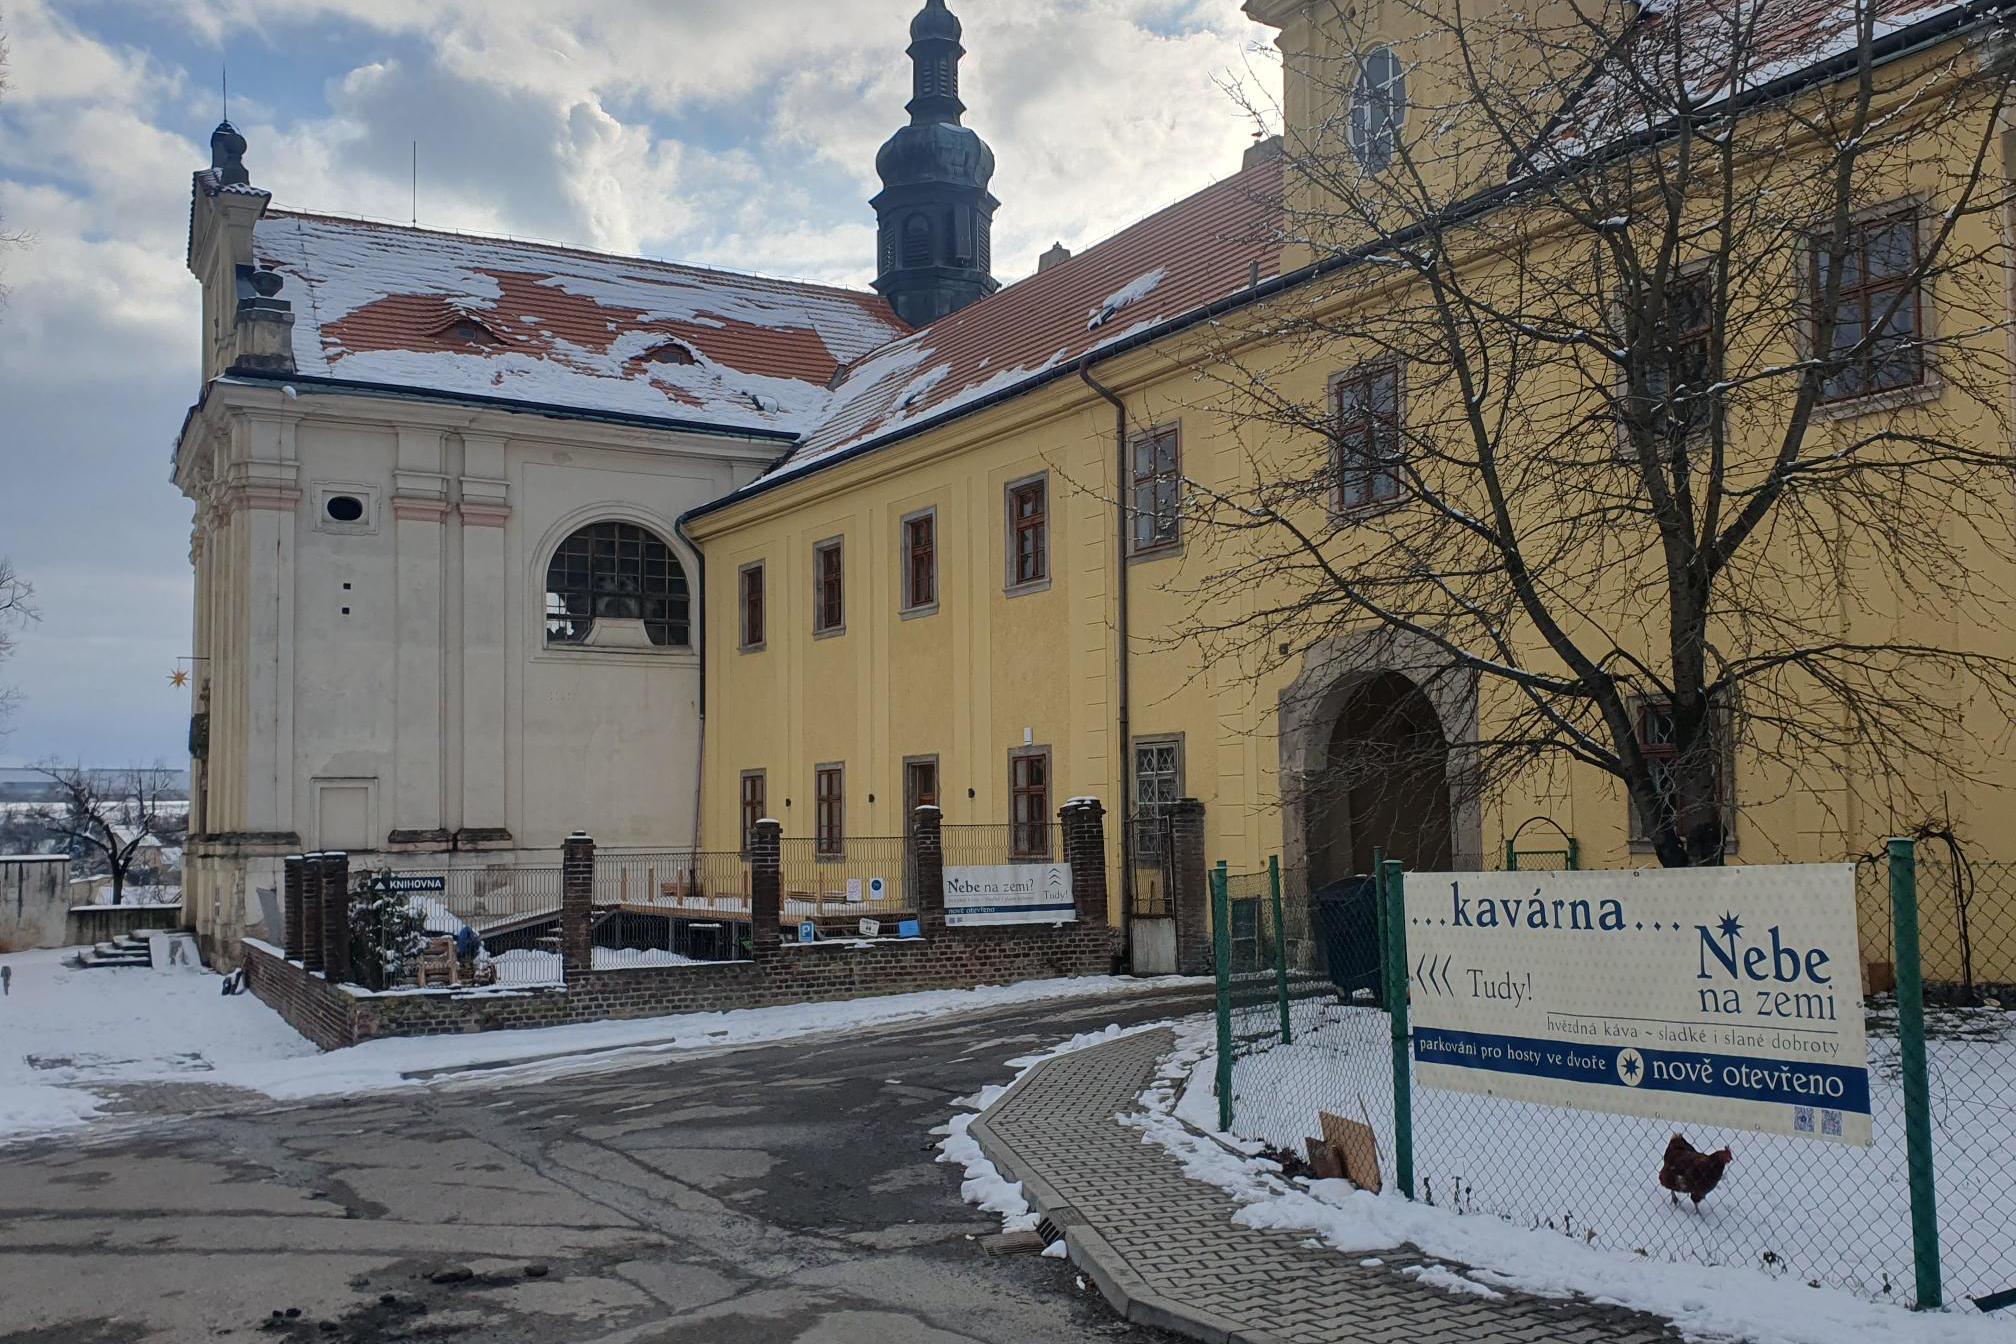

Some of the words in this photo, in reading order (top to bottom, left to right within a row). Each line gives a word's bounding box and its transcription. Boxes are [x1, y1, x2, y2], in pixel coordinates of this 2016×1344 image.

[390, 879, 442, 889] KNIHOVNA
[947, 878, 980, 893] Nebe
[984, 884, 998, 893] na
[1003, 879, 1034, 893] zemi?
[1043, 889, 1068, 901] Tudy!
[802, 924, 811, 937] P
[1694, 910, 1832, 984] Nebe
[1466, 969, 1532, 1008] Tudy!
[1698, 988, 1742, 1014] na
[1756, 985, 1838, 1020] zemi
[1547, 1016, 1597, 1036] hvězdná
[1604, 1020, 1638, 1038] káva
[1658, 1024, 1706, 1044] sladké
[1714, 1029, 1718, 1044] i
[1724, 1029, 1765, 1049] slané
[1771, 1033, 1839, 1058] dobroty
[1481, 1046, 1502, 1060] pro
[1507, 1044, 1542, 1066] hosty
[1547, 1053, 1562, 1065] ve
[1567, 1050, 1607, 1070] dvoře
[1652, 1058, 1713, 1084] nově
[1723, 1063, 1844, 1097] otevřeno
